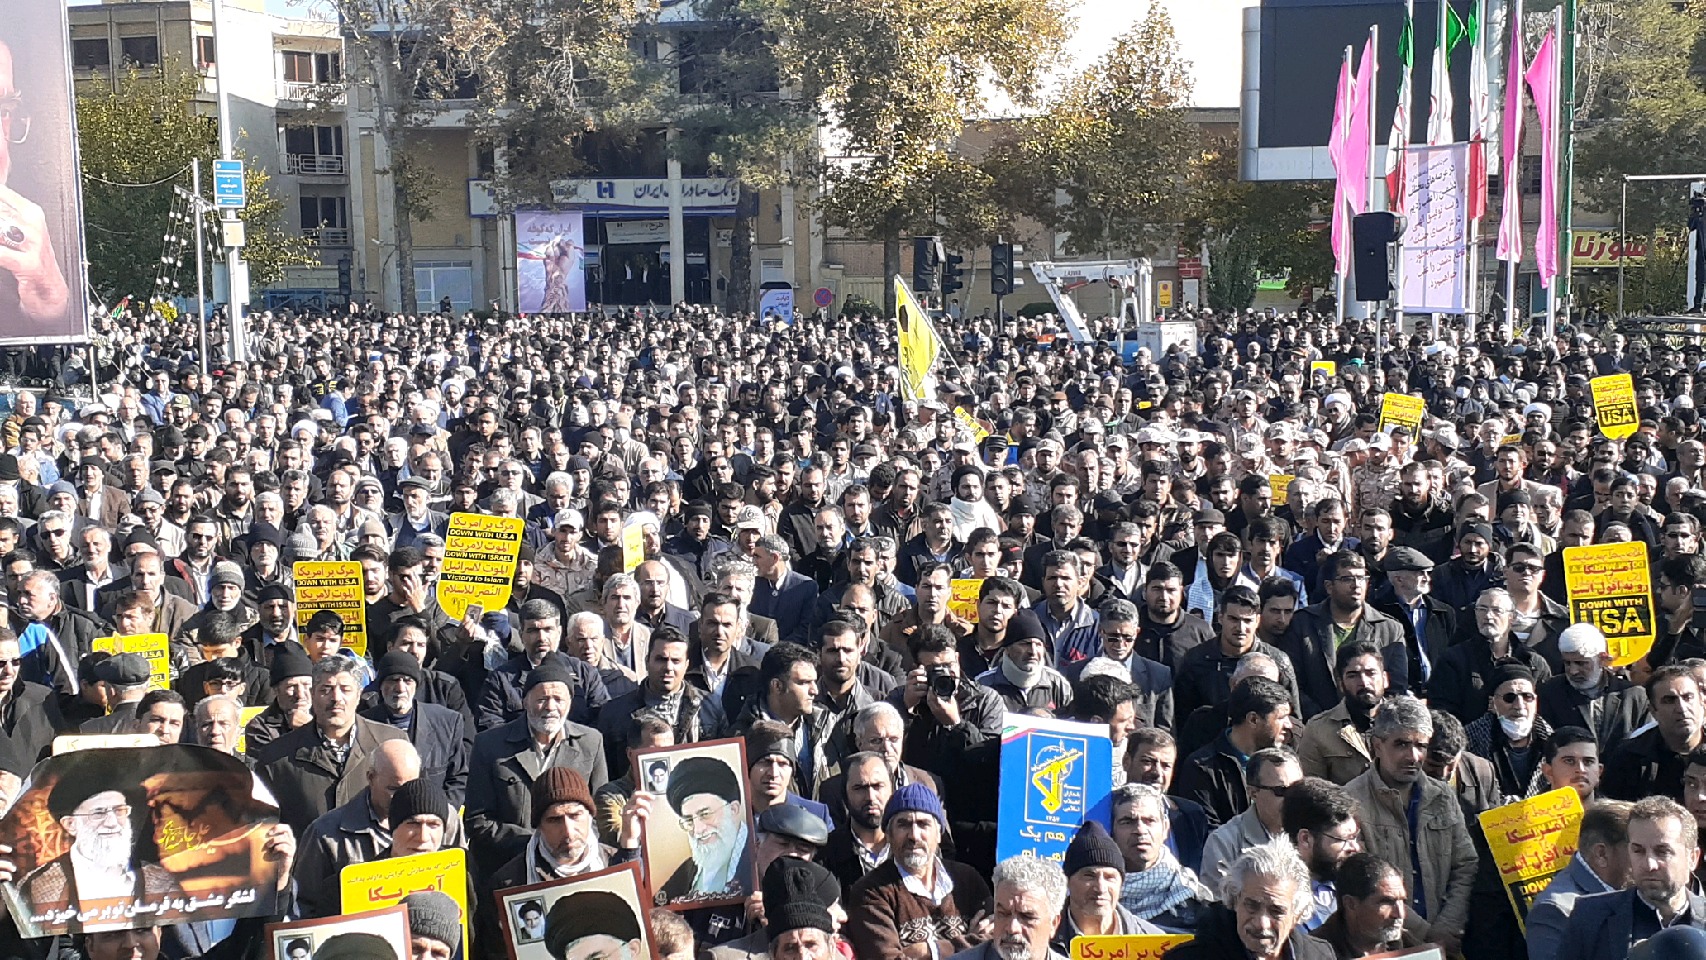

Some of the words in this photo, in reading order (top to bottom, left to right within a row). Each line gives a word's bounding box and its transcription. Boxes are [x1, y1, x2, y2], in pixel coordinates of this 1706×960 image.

[634, 183, 663, 198] ایران
[707, 179, 736, 202] بانک
[1573, 236, 1647, 261] سورنا
[1601, 408, 1634, 425] USA
[484, 523, 494, 531] بر
[494, 518, 514, 532] مرگ
[449, 528, 474, 537] DOWN
[449, 537, 484, 551] لامریکا
[485, 543, 510, 553] الموت
[445, 551, 468, 559] DOWN
[468, 552, 487, 560] WITH
[488, 554, 512, 562] ISRAEL
[336, 564, 355, 577] مرگ
[483, 564, 509, 575] الموت
[1583, 560, 1634, 576] آمریکا
[447, 573, 473, 583] Victory
[474, 574, 483, 582] to
[484, 575, 504, 583] Islam
[332, 588, 356, 599] الموت
[1570, 583, 1594, 596] است
[1598, 580, 1621, 596] افول
[1624, 582, 1634, 591] به
[1639, 583, 1649, 593] رو
[300, 588, 331, 601] لامریکا
[1579, 600, 1612, 610] DOWN
[1614, 598, 1643, 607] WITH
[1579, 607, 1645, 633] USA
[128, 642, 138, 652] بر
[139, 637, 159, 650] مرگ
[1019, 825, 1042, 843] یک
[1506, 814, 1567, 844] آمریکا
[1044, 831, 1066, 843] هم
[171, 897, 185, 913] به
[184, 891, 224, 912] عشق
[224, 888, 256, 910] لشکر
[98, 904, 111, 921] بر
[110, 900, 124, 920] تو
[124, 895, 170, 918] فرمان
[76, 907, 99, 922] می
